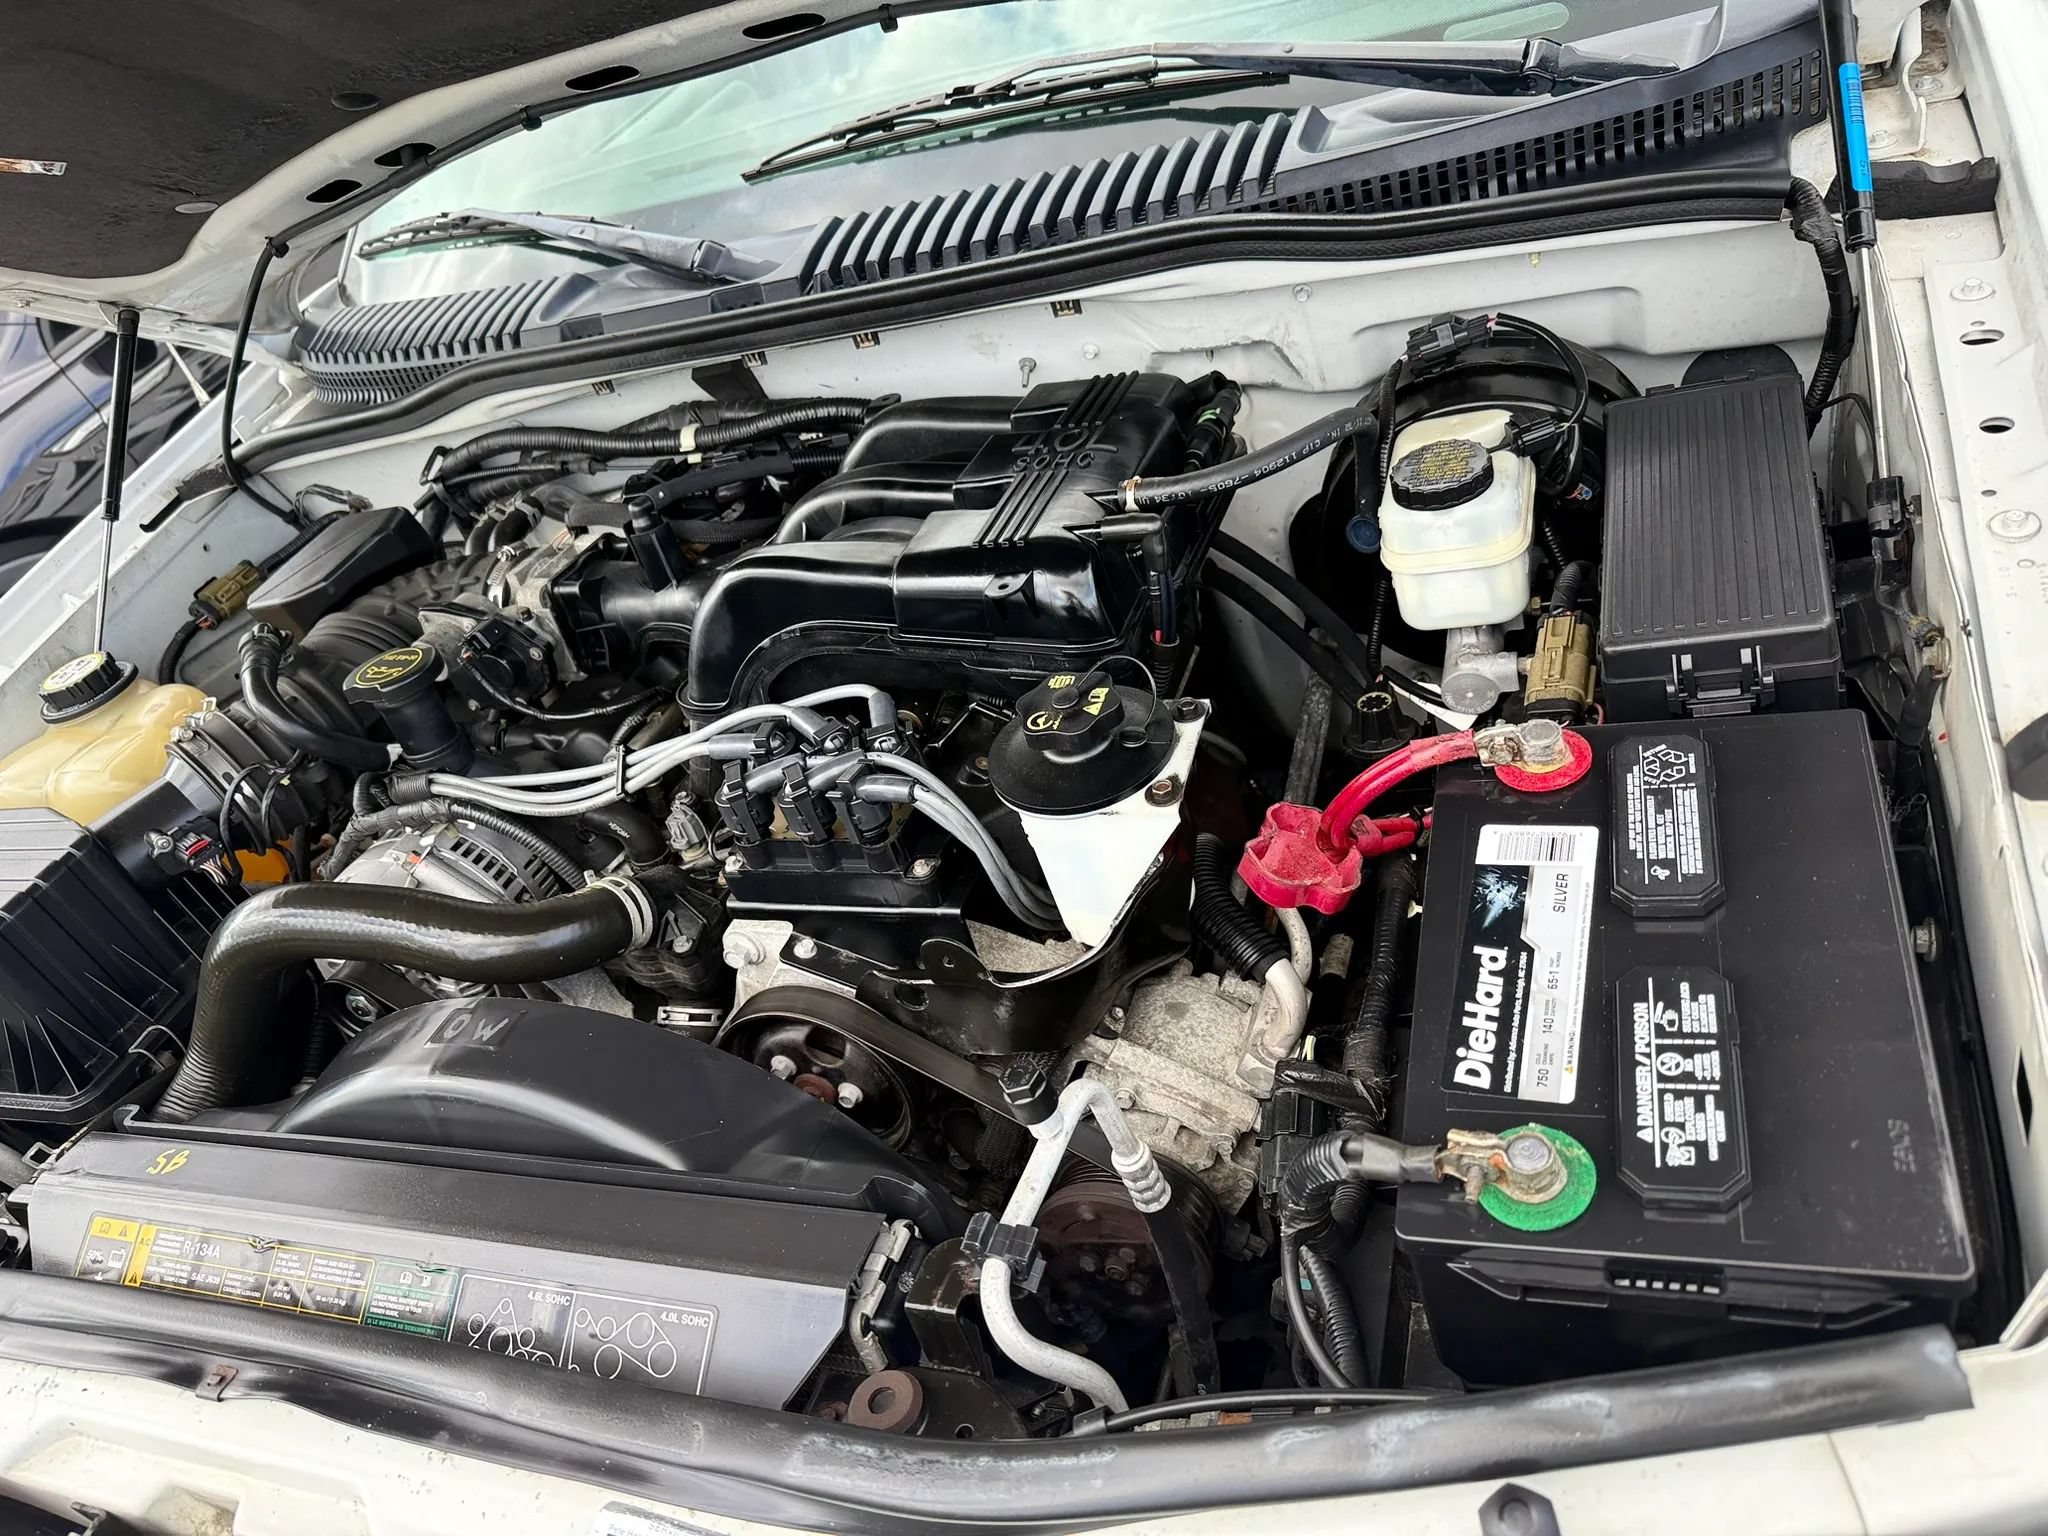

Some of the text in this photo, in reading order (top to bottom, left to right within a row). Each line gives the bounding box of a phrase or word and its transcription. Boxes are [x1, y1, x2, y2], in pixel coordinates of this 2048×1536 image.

[1302, 439, 1320, 454] CIP
[1013, 451, 1096, 472] SOHC
[1254, 452, 1297, 477] 112904
[1553, 873, 1569, 913] SILVER
[1548, 971, 1559, 989] 65-1
[1453, 945, 1508, 1089] DieHard
[1543, 1018, 1554, 1034] 140
[1537, 1069, 1549, 1088] 750
[183, 1240, 221, 1259] R-134A
[528, 1290, 571, 1306] 4.6L SOHC
[661, 1311, 709, 1328] 4.0L SOHC
